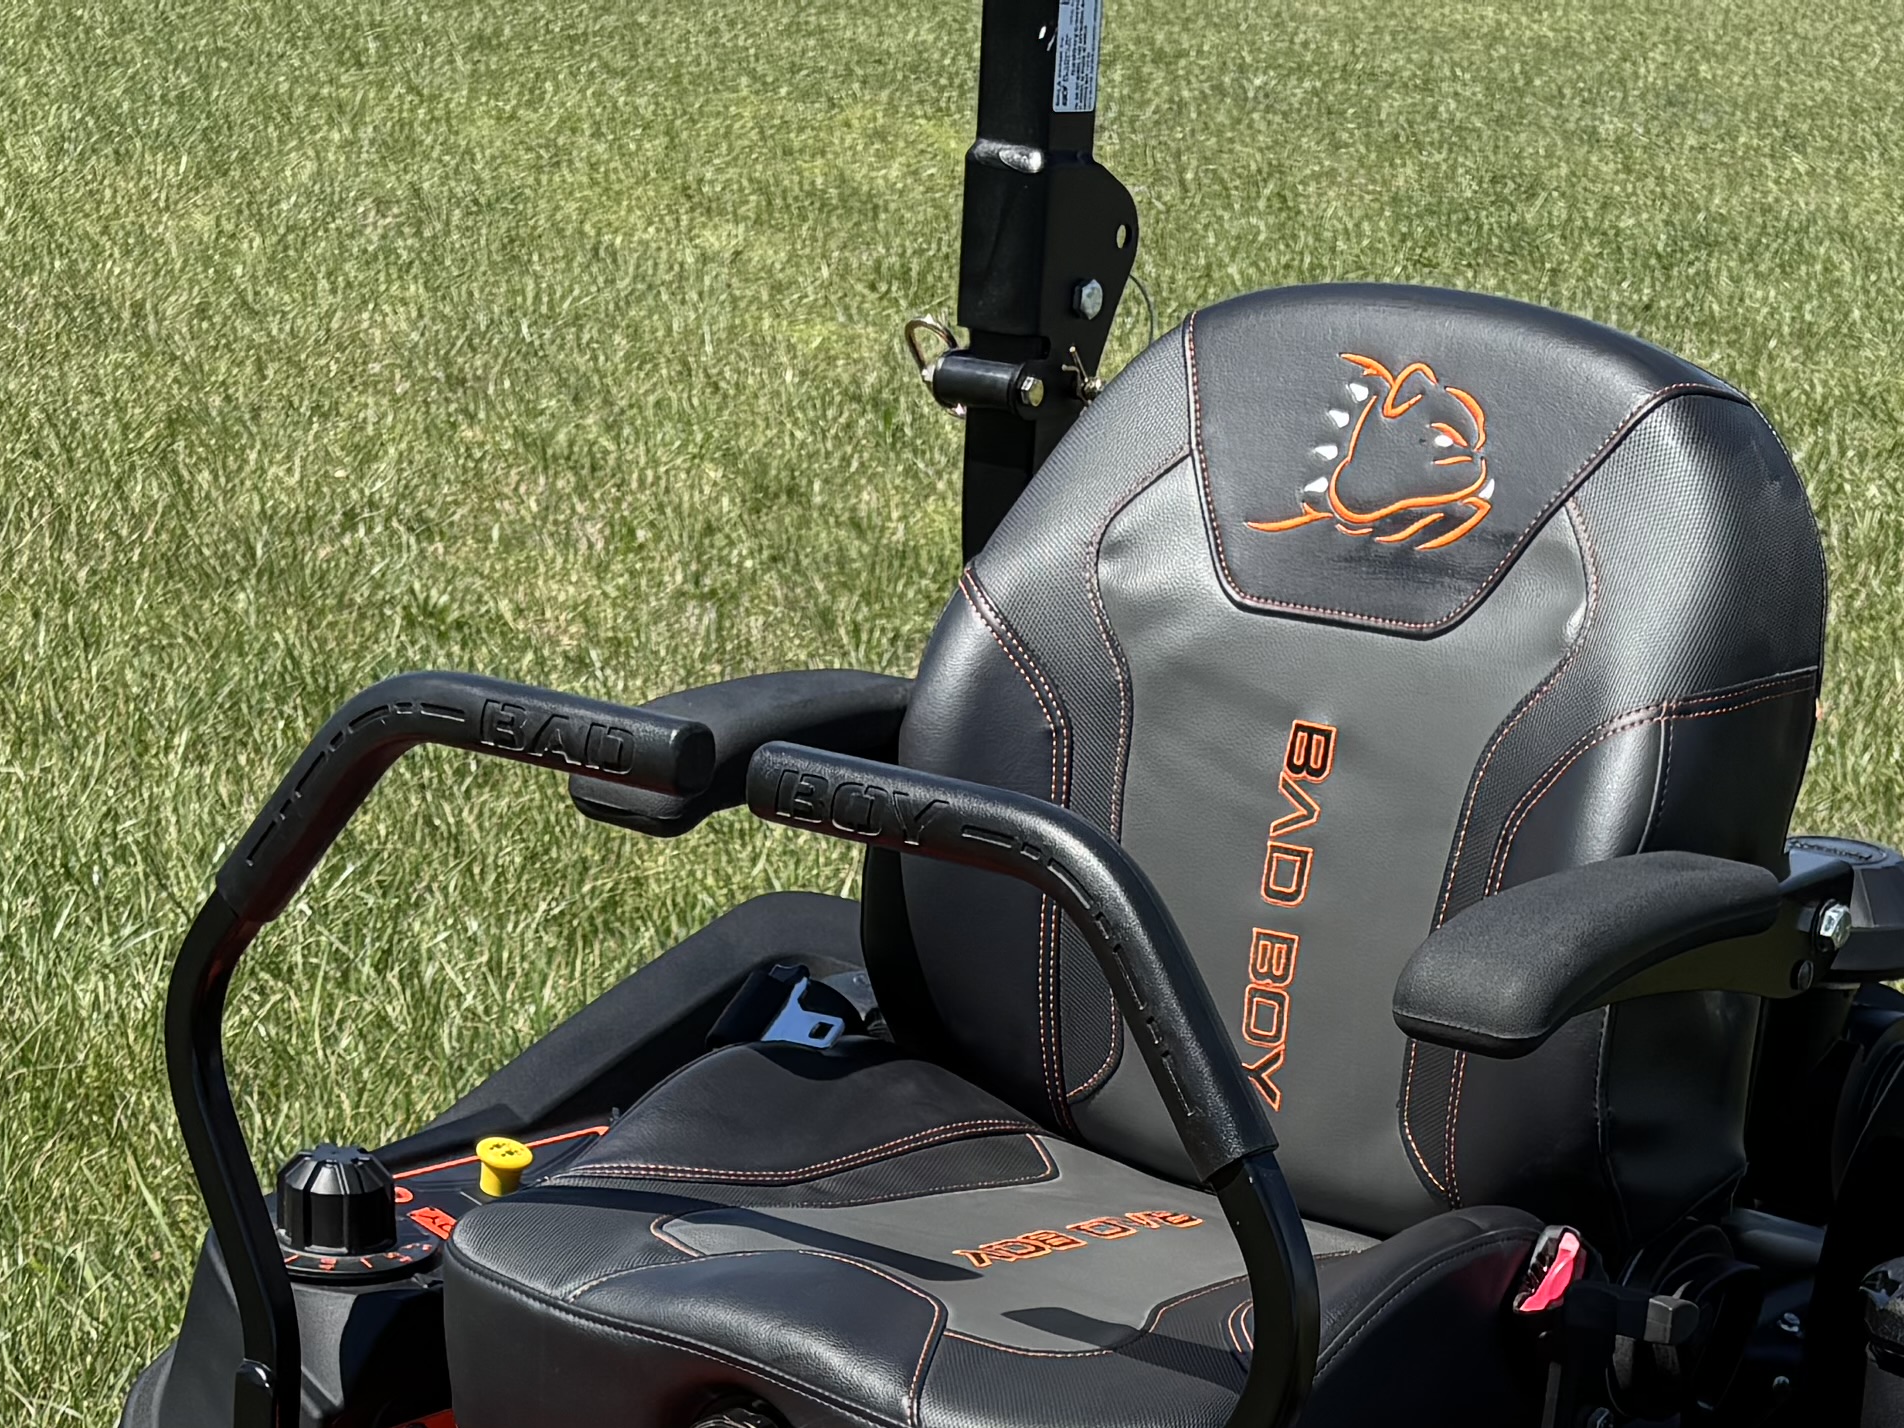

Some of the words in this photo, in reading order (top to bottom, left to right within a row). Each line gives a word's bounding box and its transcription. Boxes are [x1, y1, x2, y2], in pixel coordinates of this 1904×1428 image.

[480, 699, 637, 776] BAD
[774, 769, 950, 846] BOY
[1260, 719, 1338, 908] BAD
[1241, 926, 1300, 1113] BOY
